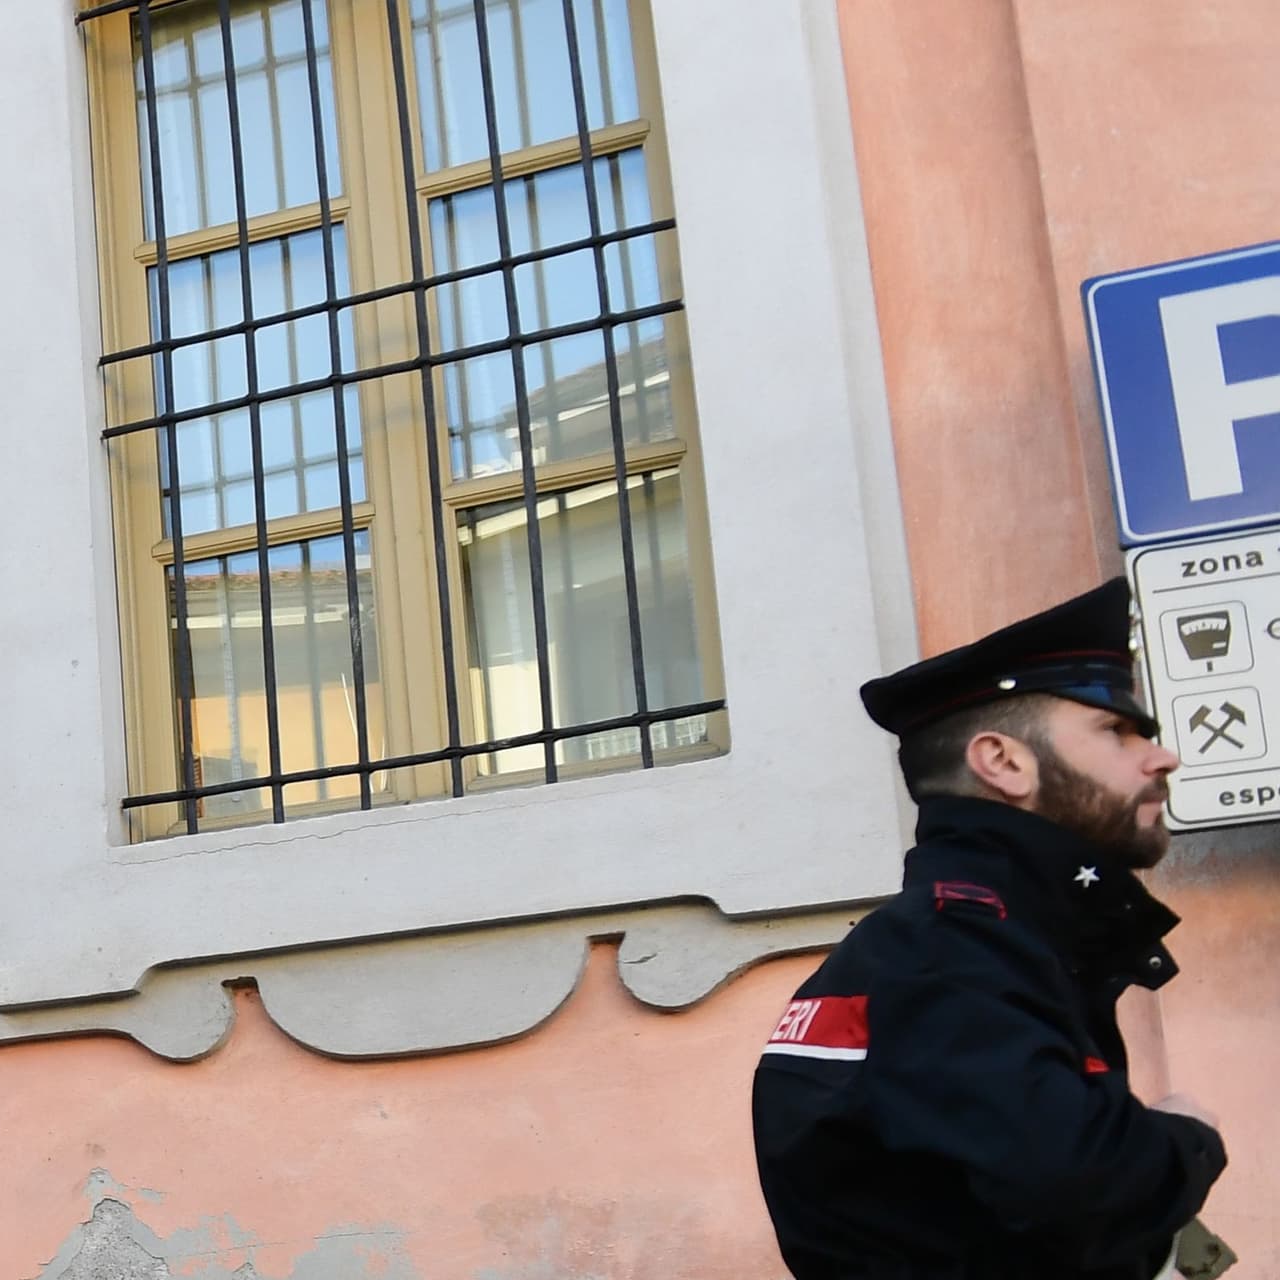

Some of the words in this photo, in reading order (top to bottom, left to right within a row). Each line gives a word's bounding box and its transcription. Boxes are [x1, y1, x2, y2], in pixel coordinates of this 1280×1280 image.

[1158, 275, 1280, 501] P
[1181, 551, 1264, 578] zona
[1218, 786, 1280, 806] esp
